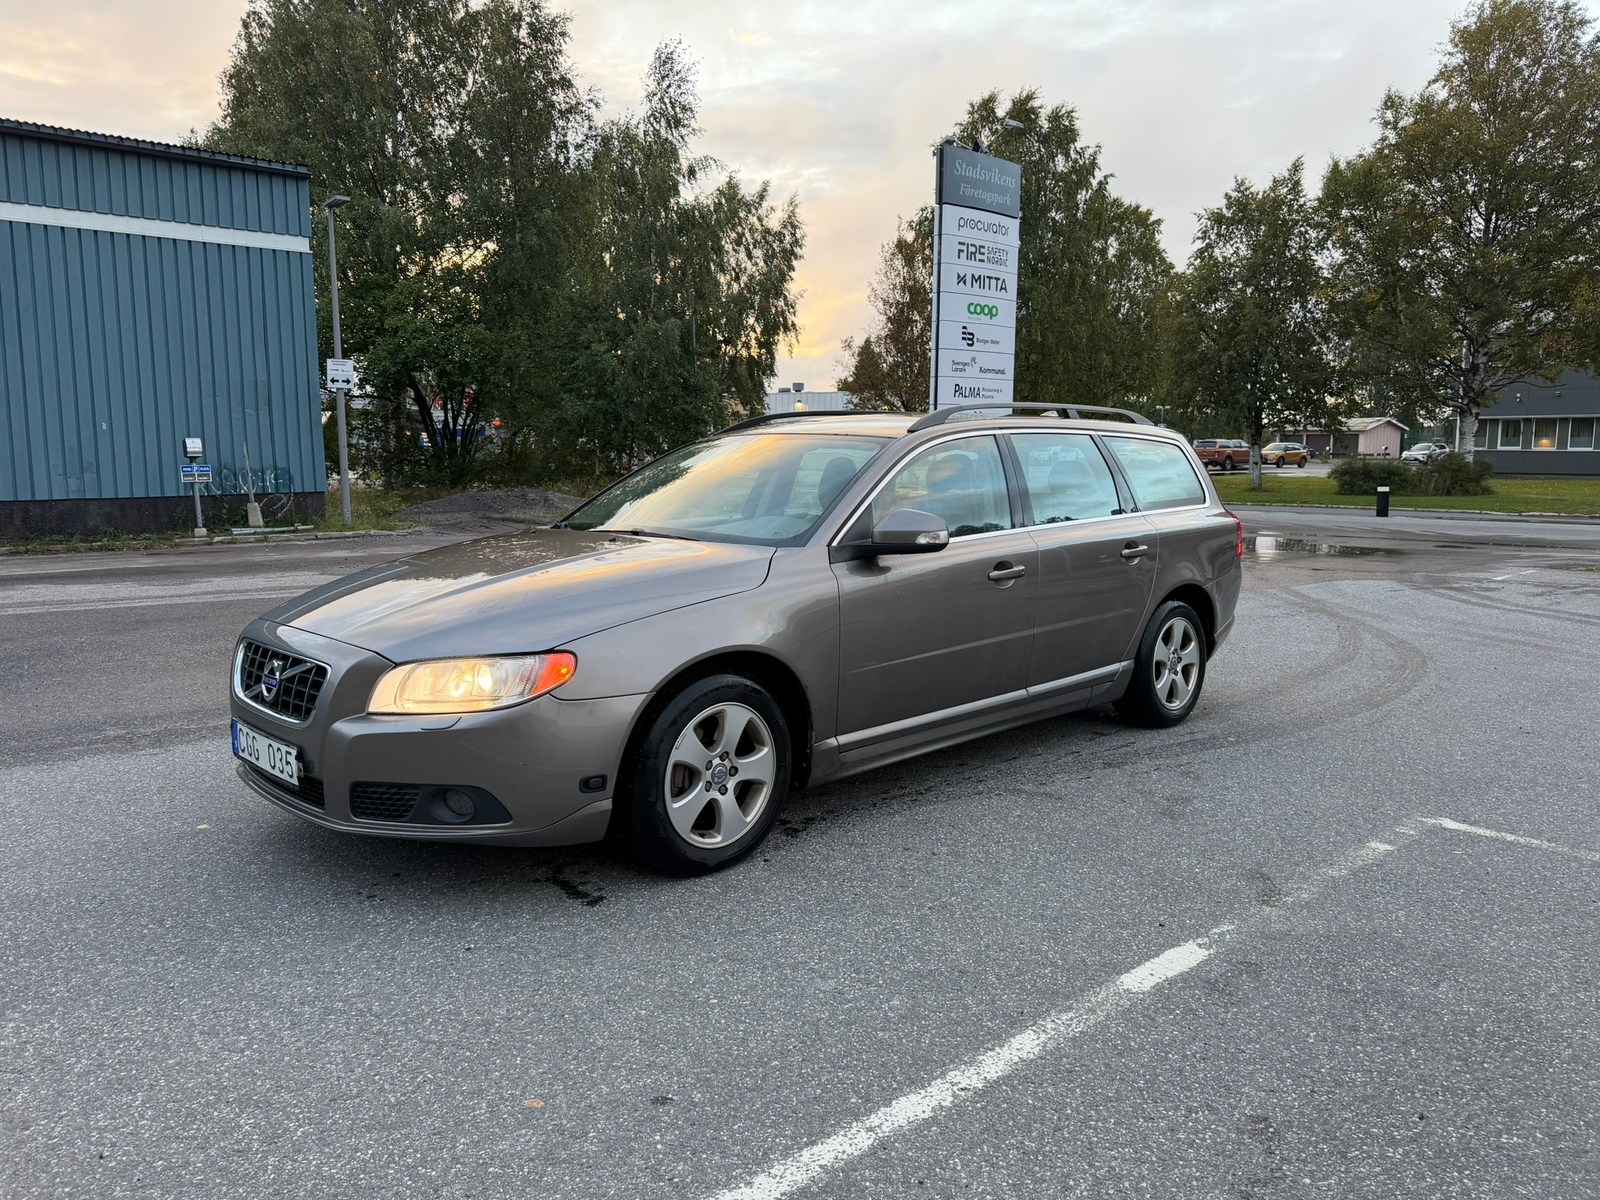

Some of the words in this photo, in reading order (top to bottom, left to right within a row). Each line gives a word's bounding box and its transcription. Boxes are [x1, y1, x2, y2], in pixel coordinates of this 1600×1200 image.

[954, 160, 1016, 188] Stadsvikens
[959, 183, 1011, 205] Företagspark
[958, 217, 1009, 236] procurator
[958, 241, 985, 263] FIRE
[986, 255, 1008, 268] NORDIC
[987, 246, 1009, 258] SAFETY
[971, 273, 1008, 293] MITTA
[967, 302, 998, 320] coop
[951, 360, 970, 368] Sveriges
[953, 383, 980, 399] PALMA
[238, 728, 260, 761] CGG
[267, 743, 294, 779] 035
